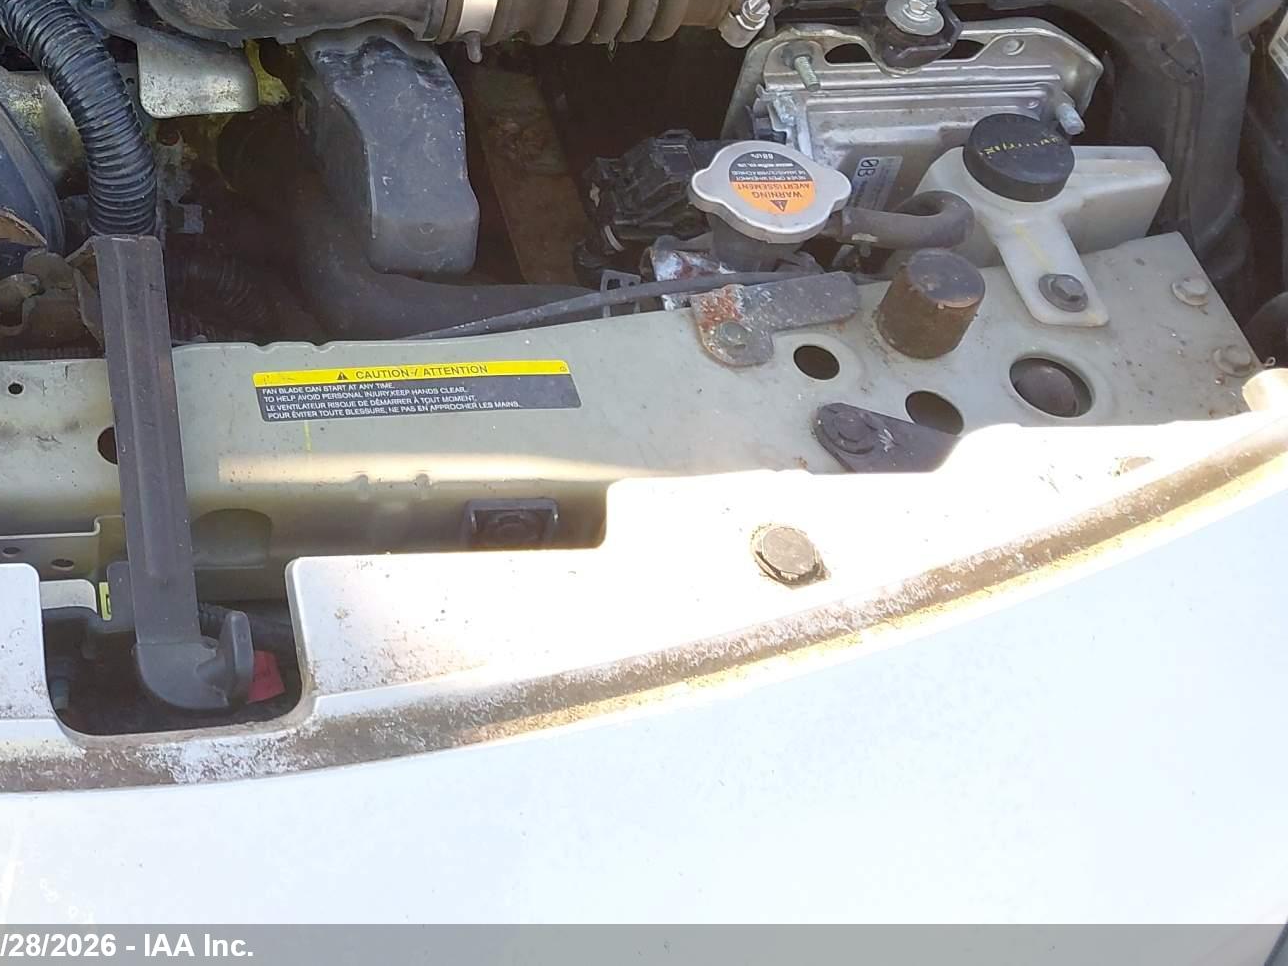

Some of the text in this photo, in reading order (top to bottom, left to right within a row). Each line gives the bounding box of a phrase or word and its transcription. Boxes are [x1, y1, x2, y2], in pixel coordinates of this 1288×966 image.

[356, 370, 408, 379] CAUTION
[424, 366, 488, 376] ATTENTION
[431, 403, 478, 411] APPROCHER
